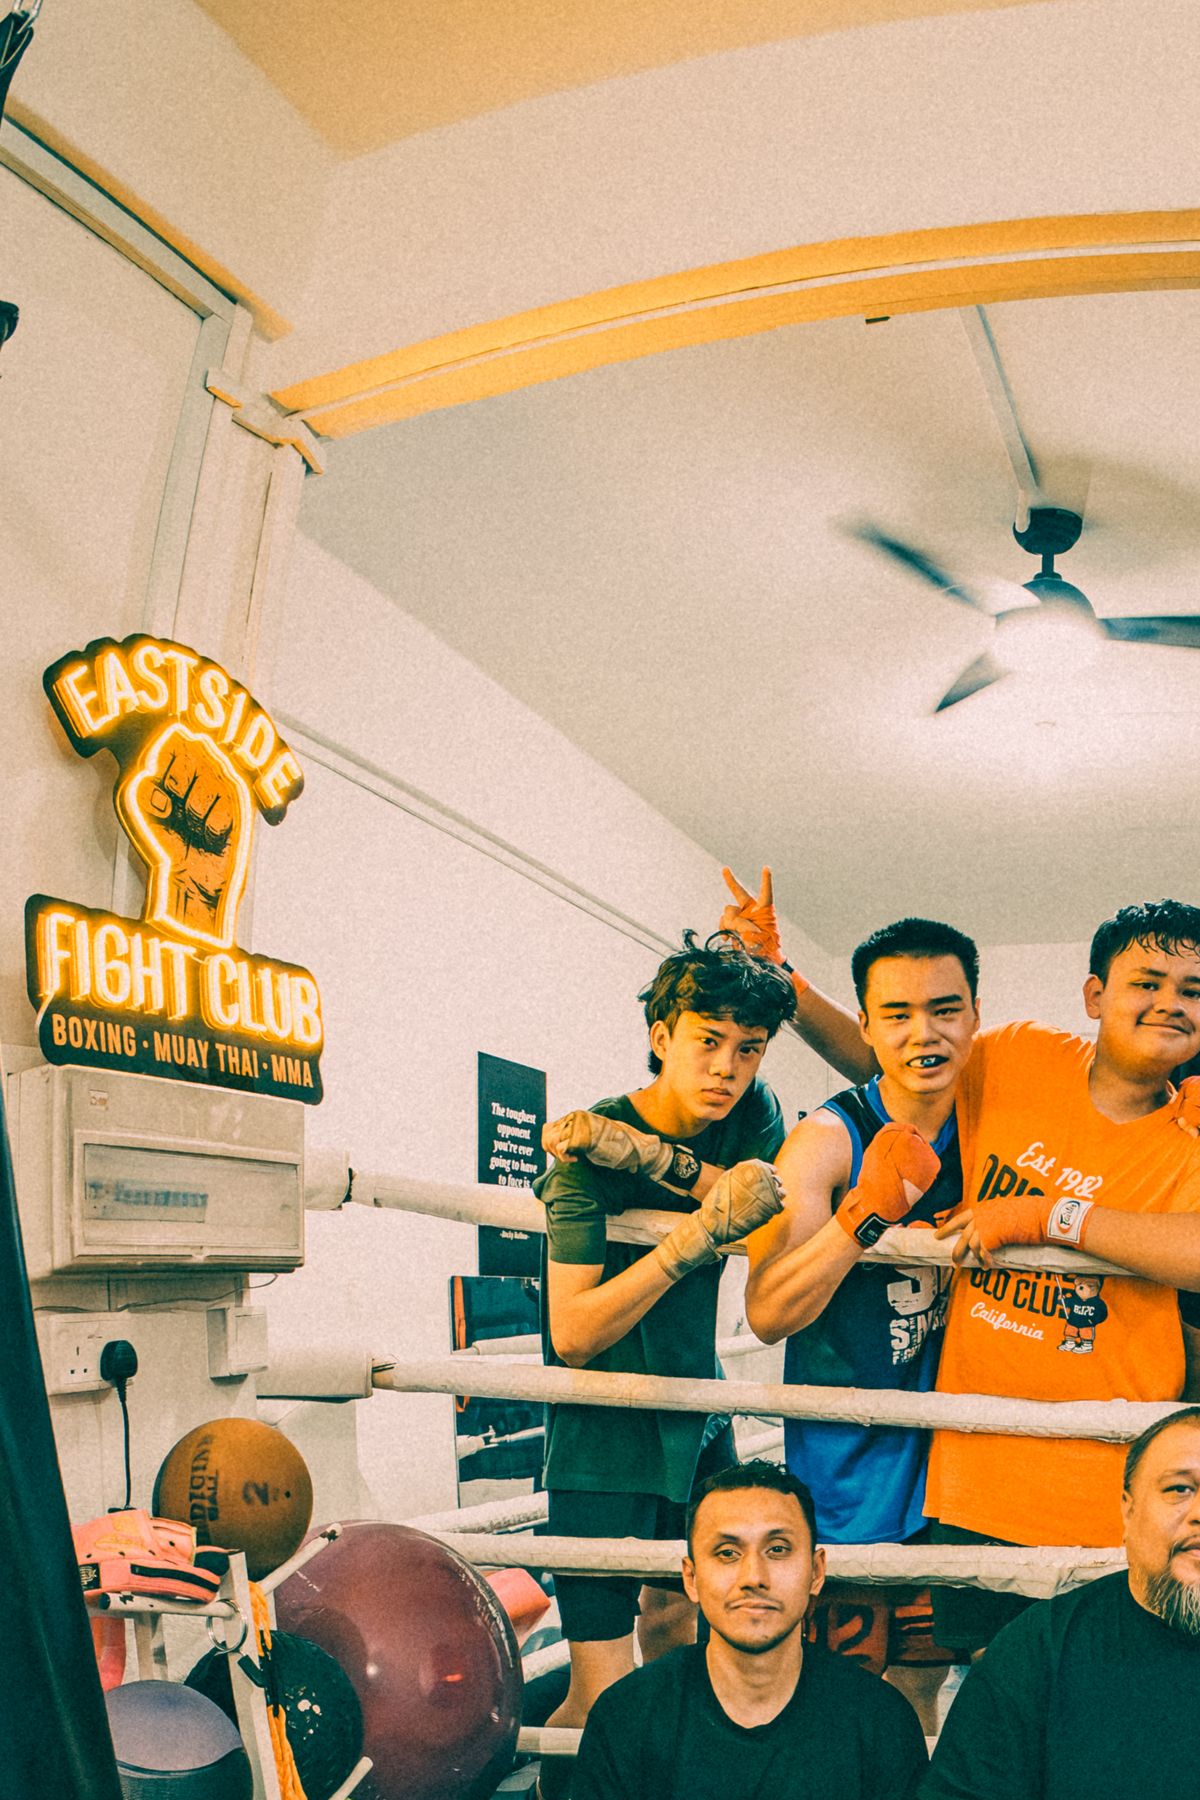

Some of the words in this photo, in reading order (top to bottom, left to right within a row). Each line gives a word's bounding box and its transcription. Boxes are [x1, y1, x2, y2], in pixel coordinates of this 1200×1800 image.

[56, 645, 302, 809] EASTSIDE
[38, 912, 197, 1020] FIGHT
[200, 953, 321, 1047] CLUB
[52, 1013, 137, 1057] BOXING
[153, 1030, 209, 1069] MUAY
[214, 1043, 260, 1079] THAI
[270, 1054, 314, 1088] MMA
[491, 1102, 505, 1117] The
[506, 1108, 536, 1125] toughest
[497, 1123, 531, 1140] opponent
[493, 1140, 517, 1154] you're
[518, 1145, 534, 1157] ever
[489, 1156, 511, 1172] going
[512, 1160, 519, 1171] to
[520, 1160, 538, 1174] have
[1016, 1141, 1056, 1177] Est
[1055, 1167, 1103, 1199] 1982
[498, 1174, 507, 1186] to
[508, 1174, 523, 1188] face
[523, 1177, 531, 1189] is
[970, 1302, 1044, 1340] California
[242, 1481, 269, 1506] 2
